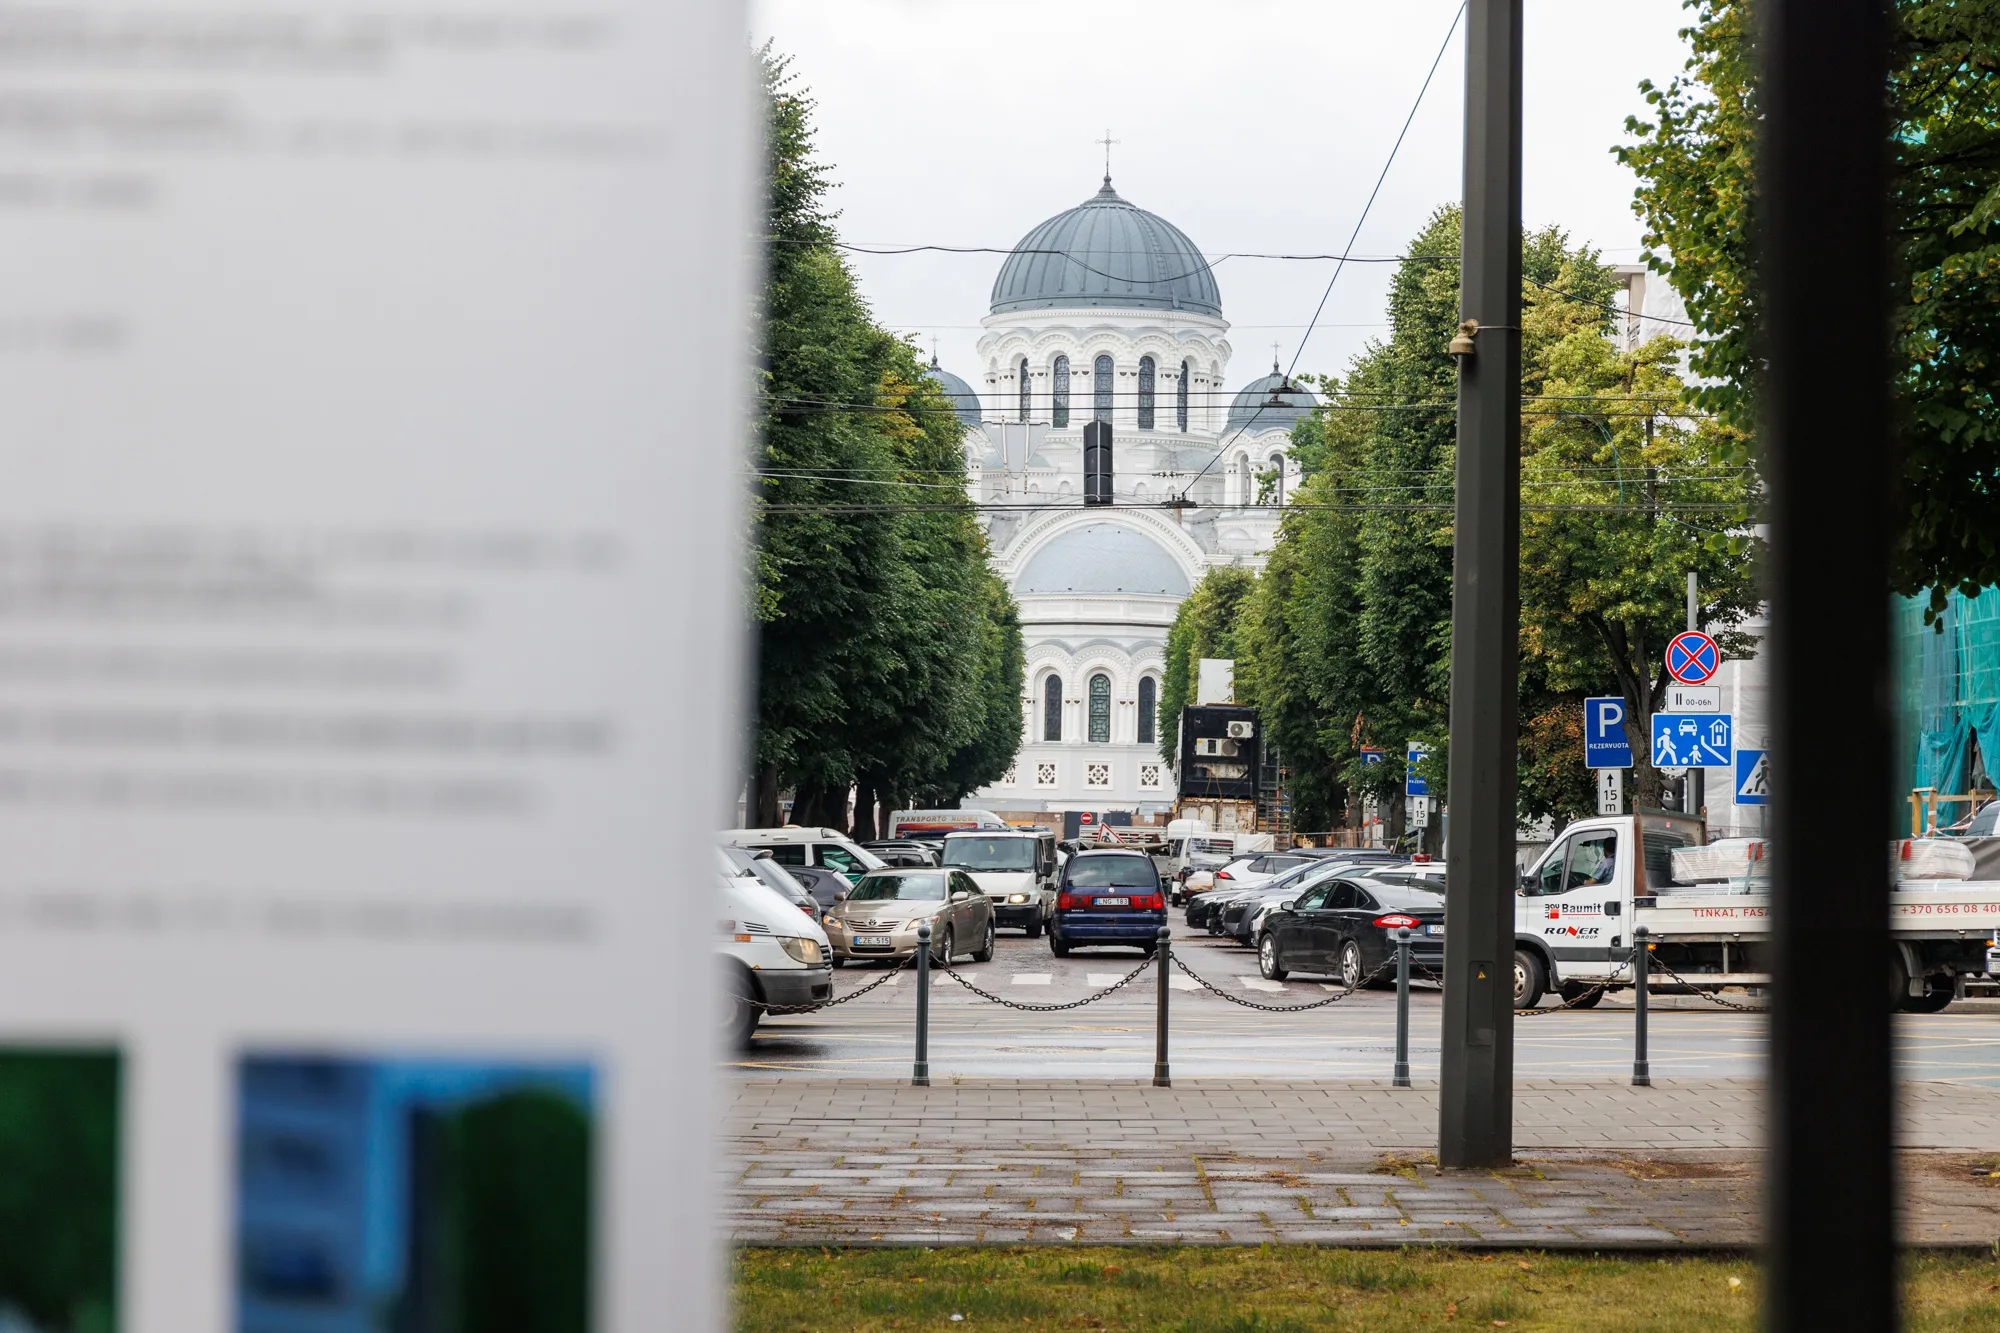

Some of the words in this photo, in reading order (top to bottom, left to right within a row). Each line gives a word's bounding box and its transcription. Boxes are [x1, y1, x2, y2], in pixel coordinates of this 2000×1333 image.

[1599, 703, 1623, 738] P
[1588, 742, 1630, 750] REZERVUOTA
[1603, 790, 1618, 801] 15
[1605, 803, 1616, 812] m
[1416, 810, 1426, 819] 15
[1561, 903, 1602, 913] Baumit
[1692, 908, 1738, 918] TINKAI,
[1901, 905, 1932, 915] +370
[1936, 904, 1959, 914] 656
[1963, 904, 1978, 913] 08
[1982, 904, 2000, 913] 40
